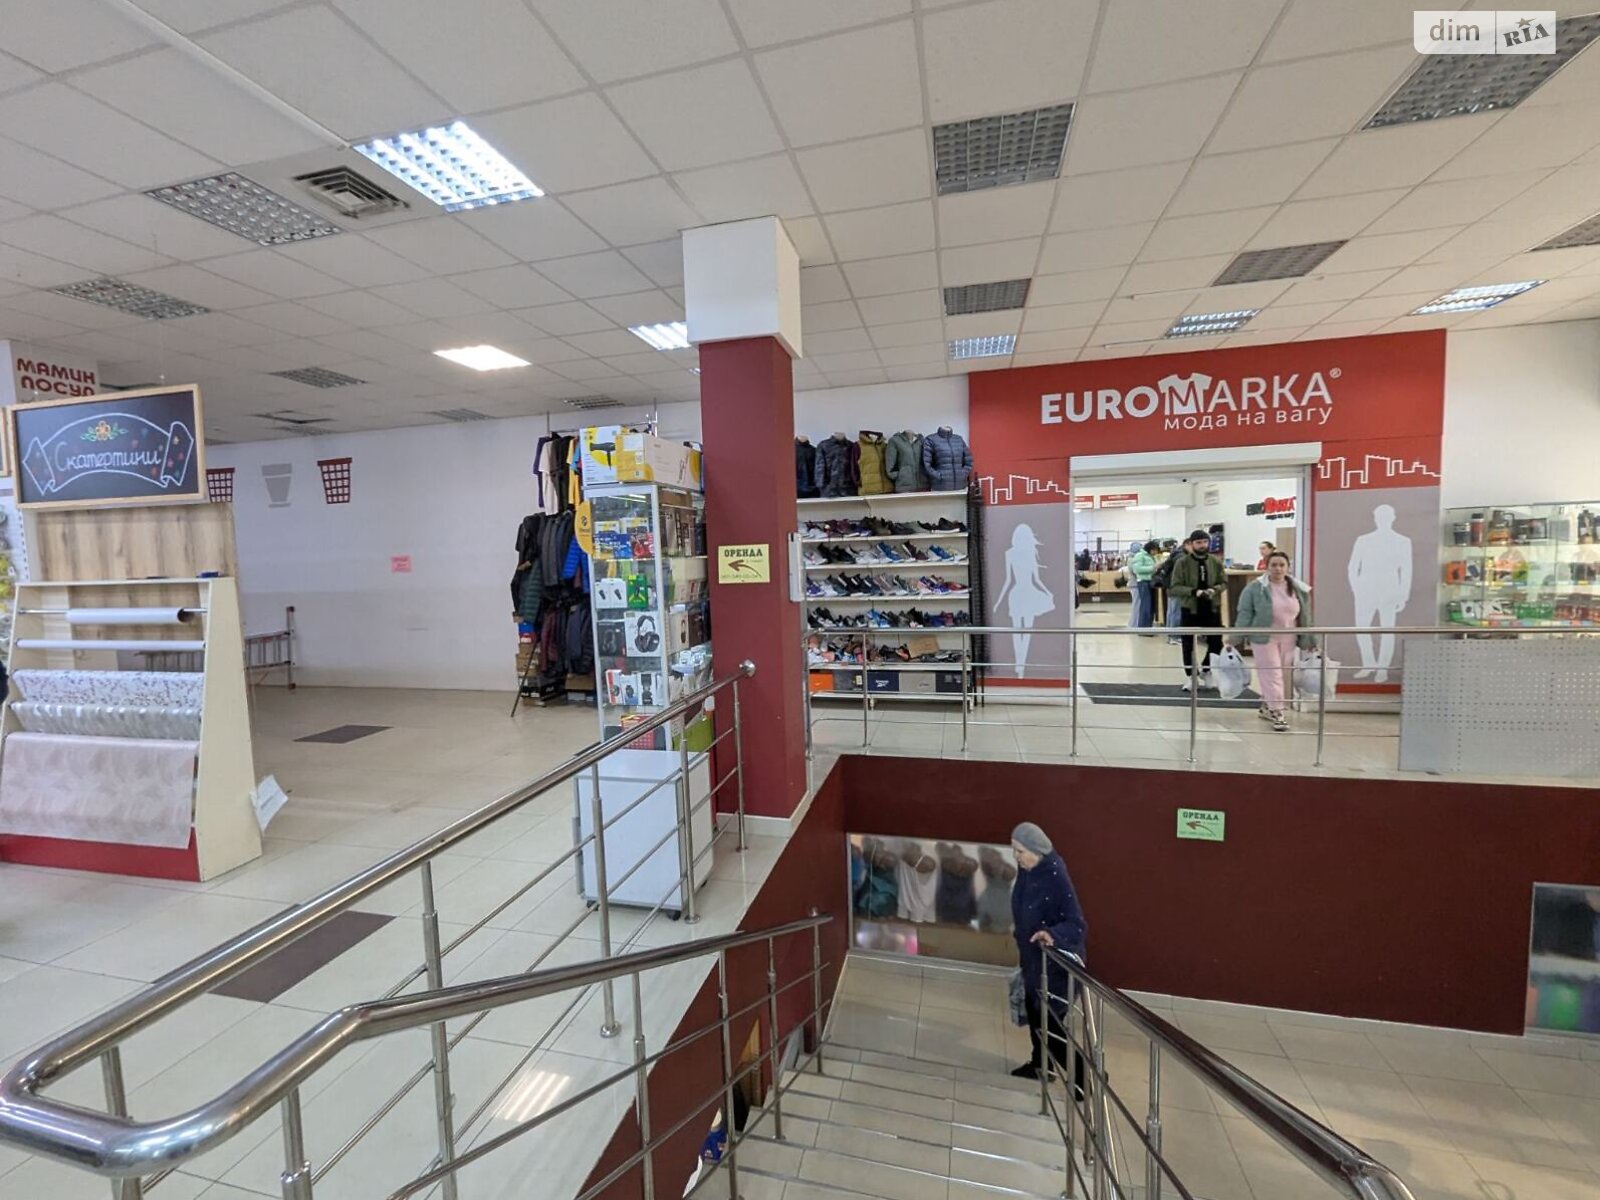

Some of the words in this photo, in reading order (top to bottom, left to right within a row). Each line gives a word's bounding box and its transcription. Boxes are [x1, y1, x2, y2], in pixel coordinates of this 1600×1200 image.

[17, 358, 96, 384] МАМИН
[1164, 413, 1228, 431] мода
[1237, 410, 1266, 426] на
[1276, 406, 1333, 425] вагу
[54, 441, 163, 472] Скатертини
[724, 548, 763, 558] ОРЕНДА
[1182, 811, 1219, 821] ОРЕНДА
